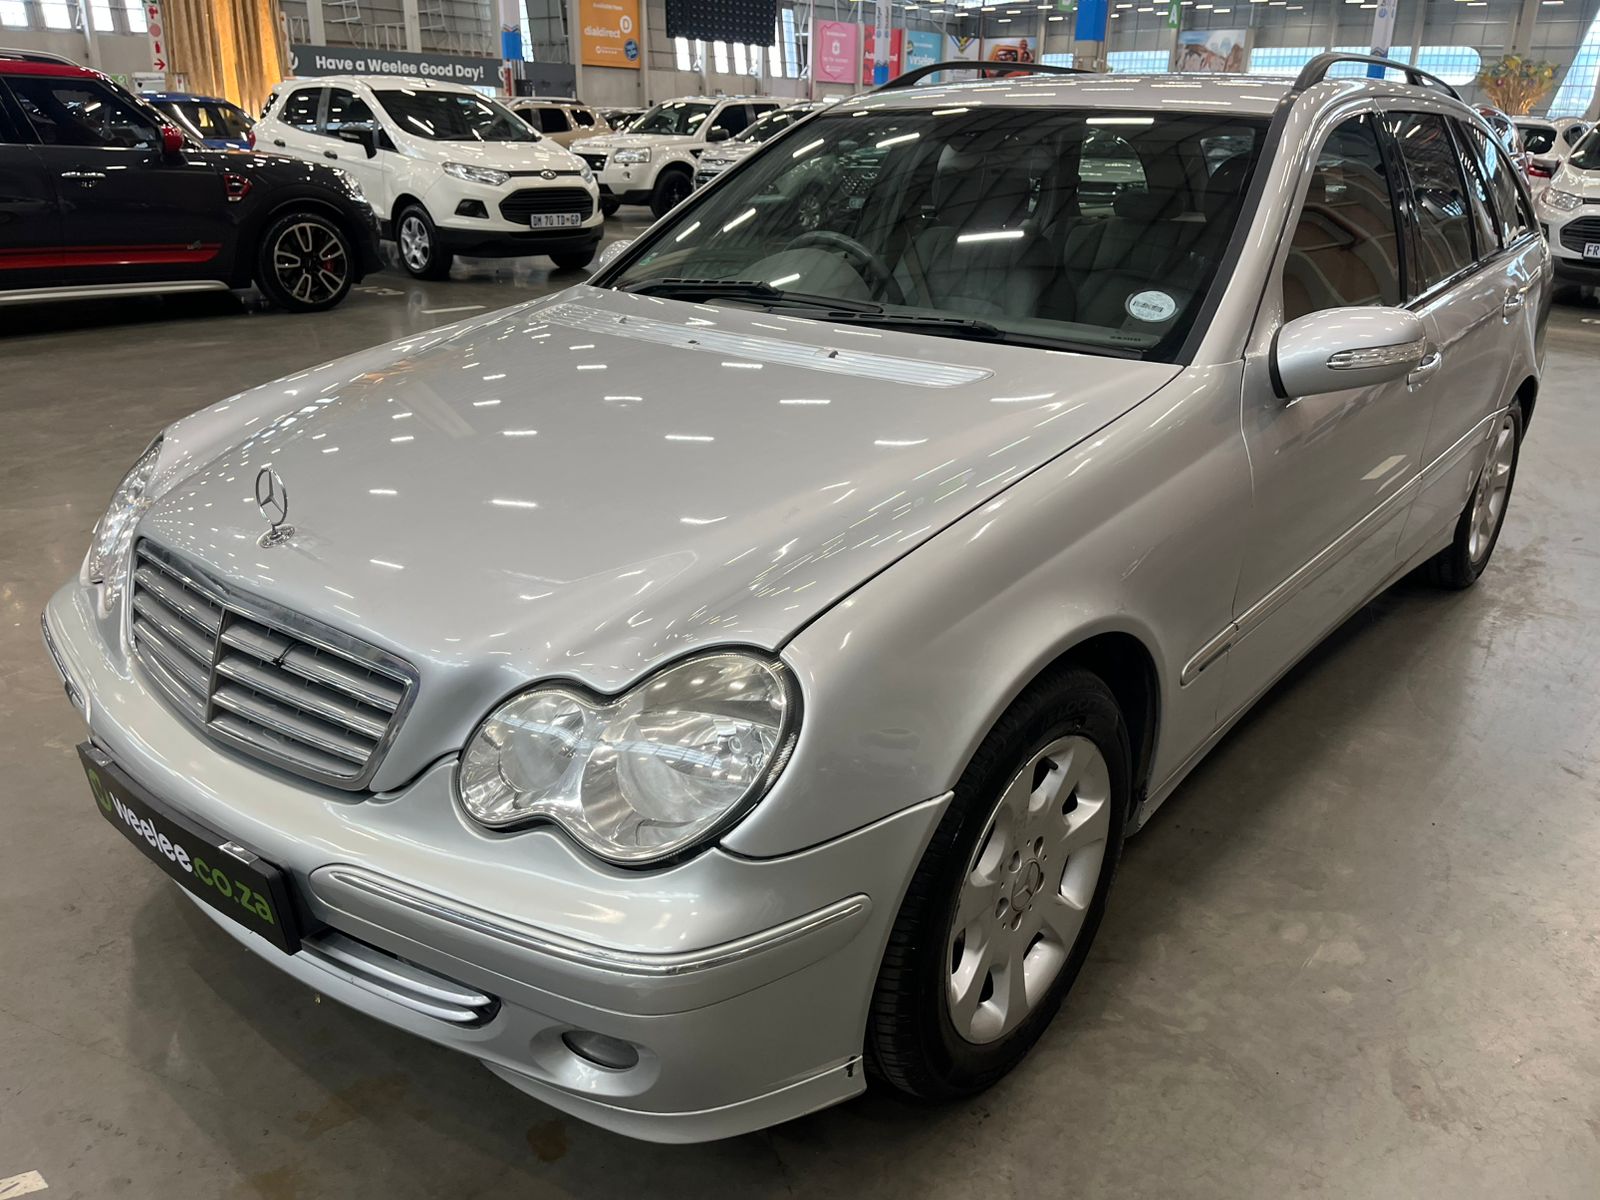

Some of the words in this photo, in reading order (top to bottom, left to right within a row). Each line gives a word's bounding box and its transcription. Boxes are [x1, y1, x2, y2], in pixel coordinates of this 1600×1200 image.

[1168, 4, 1178, 25] A
[315, 55, 353, 70] Have
[355, 59, 365, 71] a
[367, 58, 417, 75] Weelee
[420, 62, 453, 77] Good
[455, 65, 484, 82] Day!
[1586, 244, 1600, 256] FR
[109, 791, 275, 925] weelee.co.za
